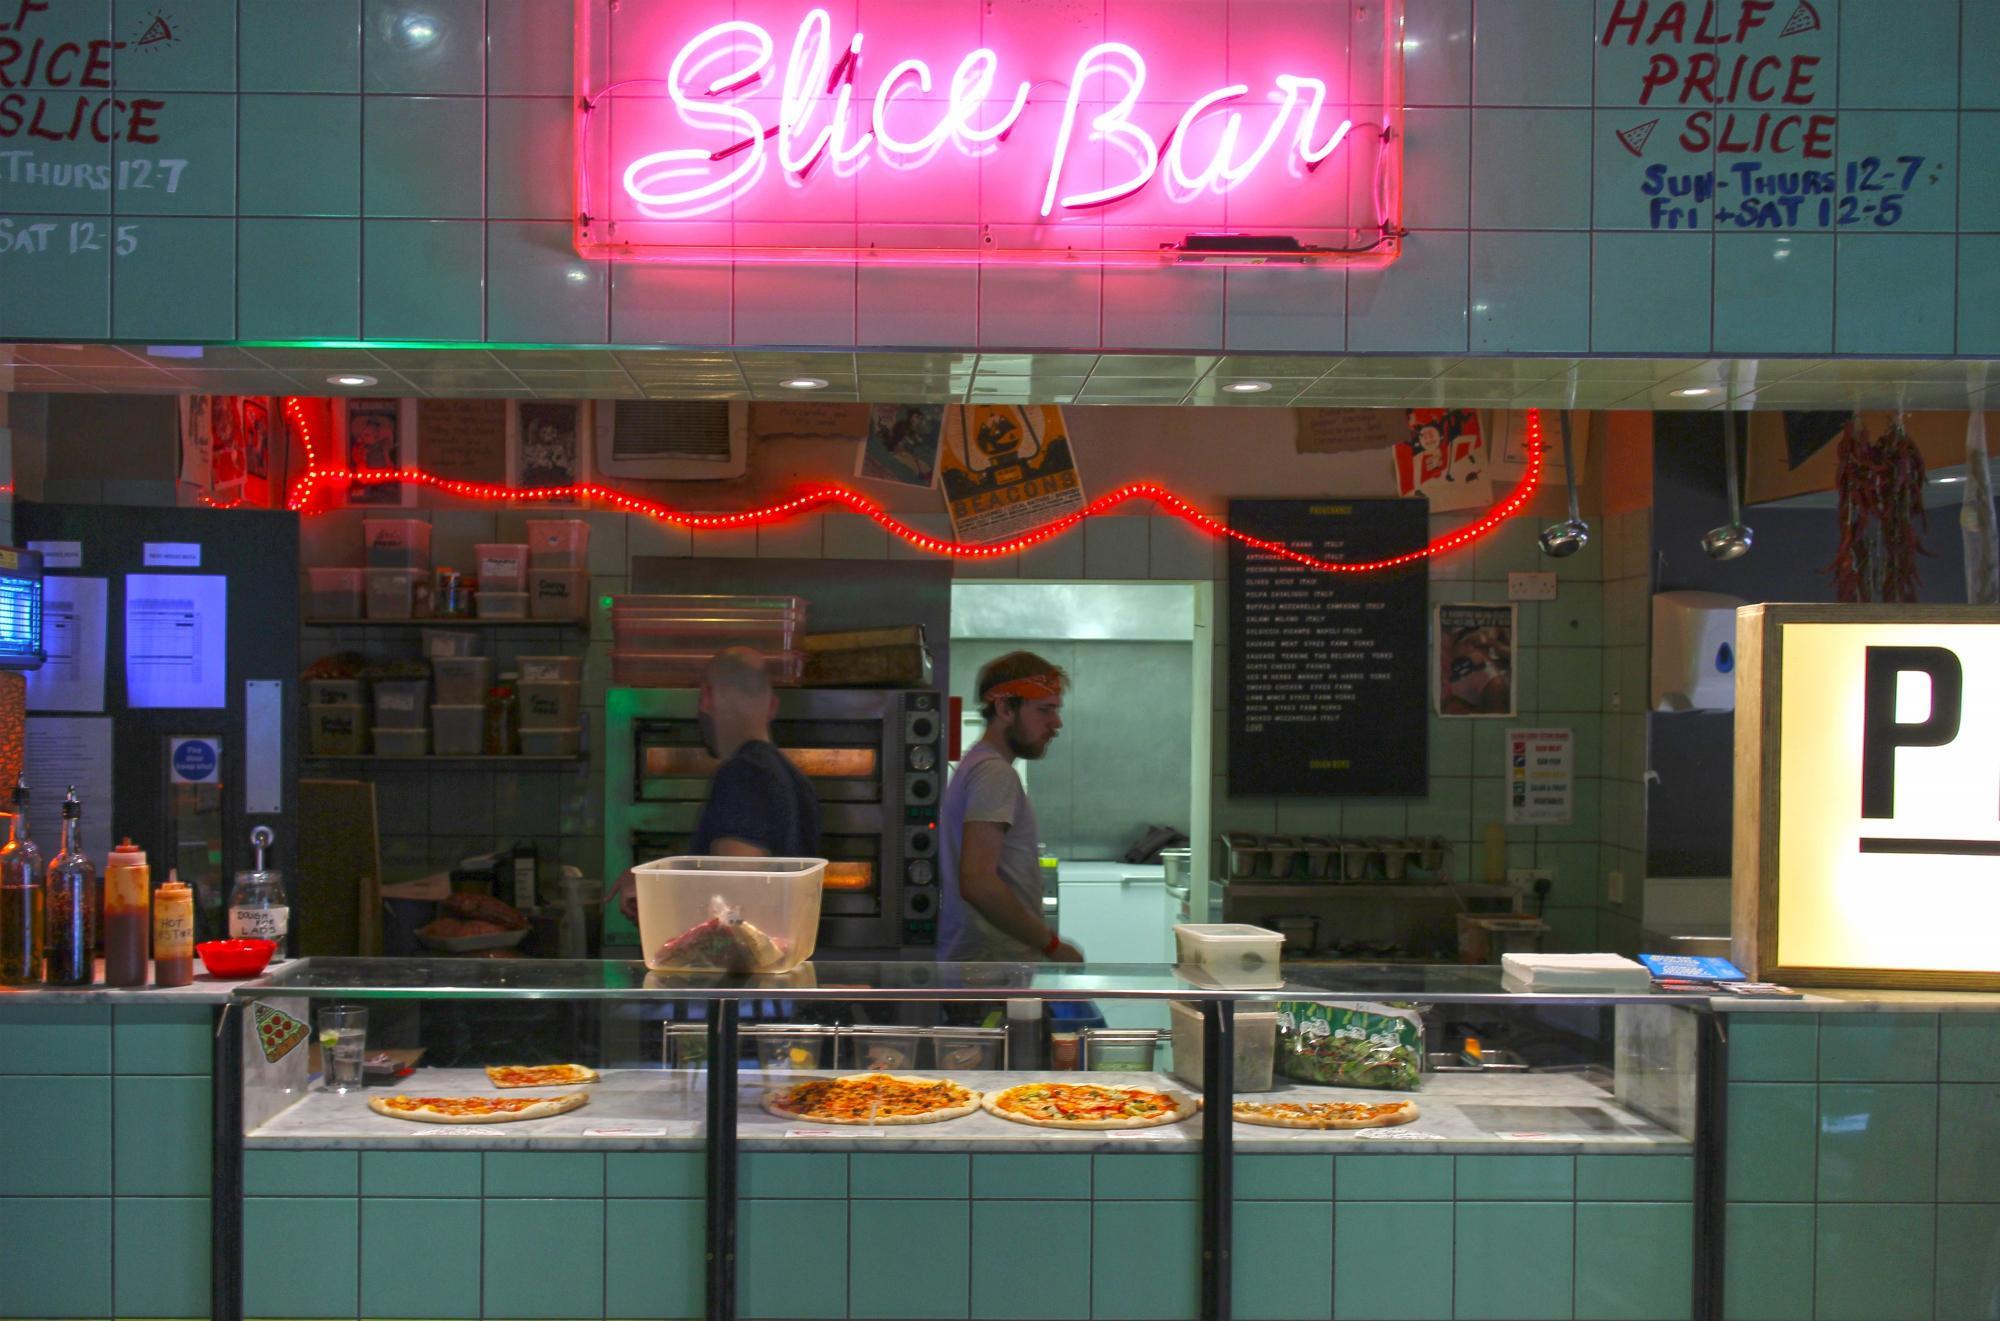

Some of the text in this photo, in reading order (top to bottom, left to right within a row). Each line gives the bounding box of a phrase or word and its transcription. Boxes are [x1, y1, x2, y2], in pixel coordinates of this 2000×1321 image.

[0, 0, 49, 31] F
[1602, 0, 1775, 46] HALF
[1638, 53, 1822, 106] PRICE
[0, 93, 165, 144] SLICE
[623, 8, 1352, 217] Slice Bar
[1678, 111, 1838, 158] SLICE
[118, 159, 189, 193] 12-7
[69, 221, 139, 256] 12-5
[954, 472, 1076, 518] BEACONS
[1861, 646, 2000, 821] P
[160, 918, 185, 929] HOT
[241, 926, 277, 936] LADS
